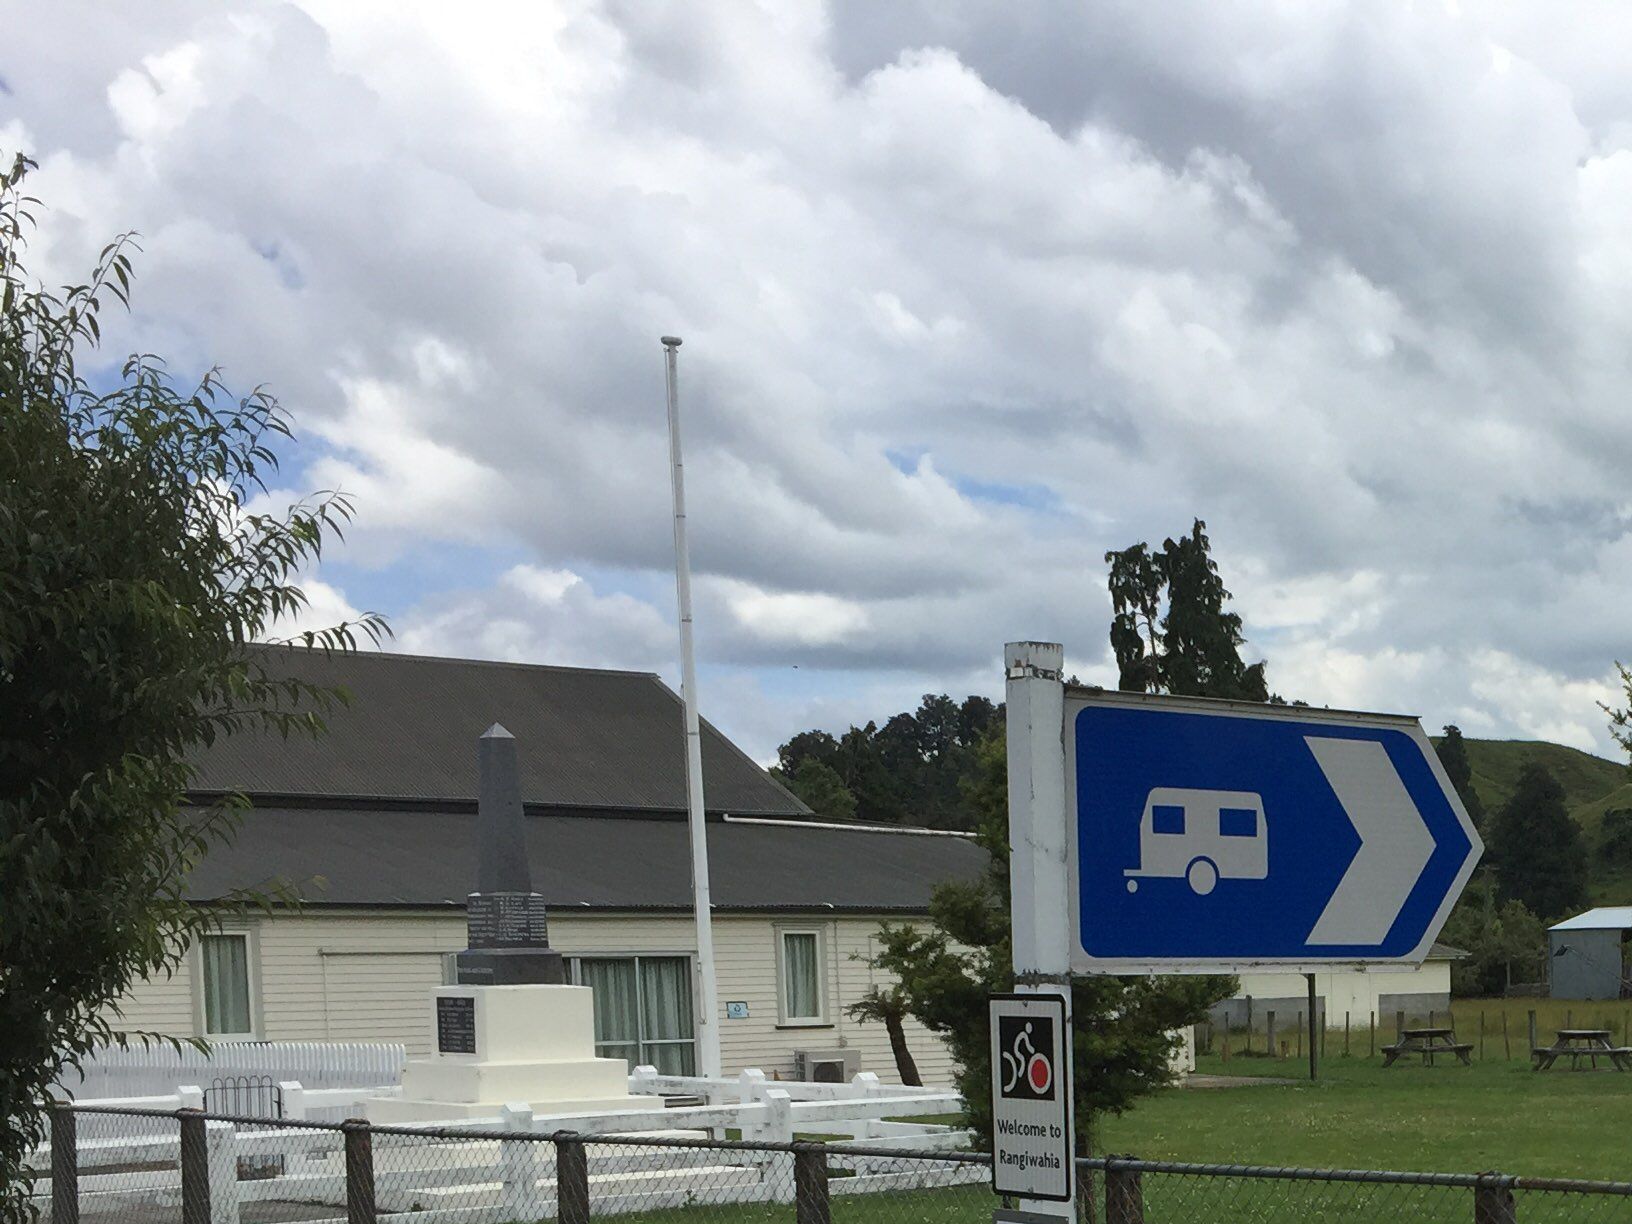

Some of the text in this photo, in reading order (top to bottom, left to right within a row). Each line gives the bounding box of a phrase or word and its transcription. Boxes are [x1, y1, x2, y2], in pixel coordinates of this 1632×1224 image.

[997, 1119, 1062, 1138] Welcome to
[1000, 1149, 1060, 1170] Rangiwahia
